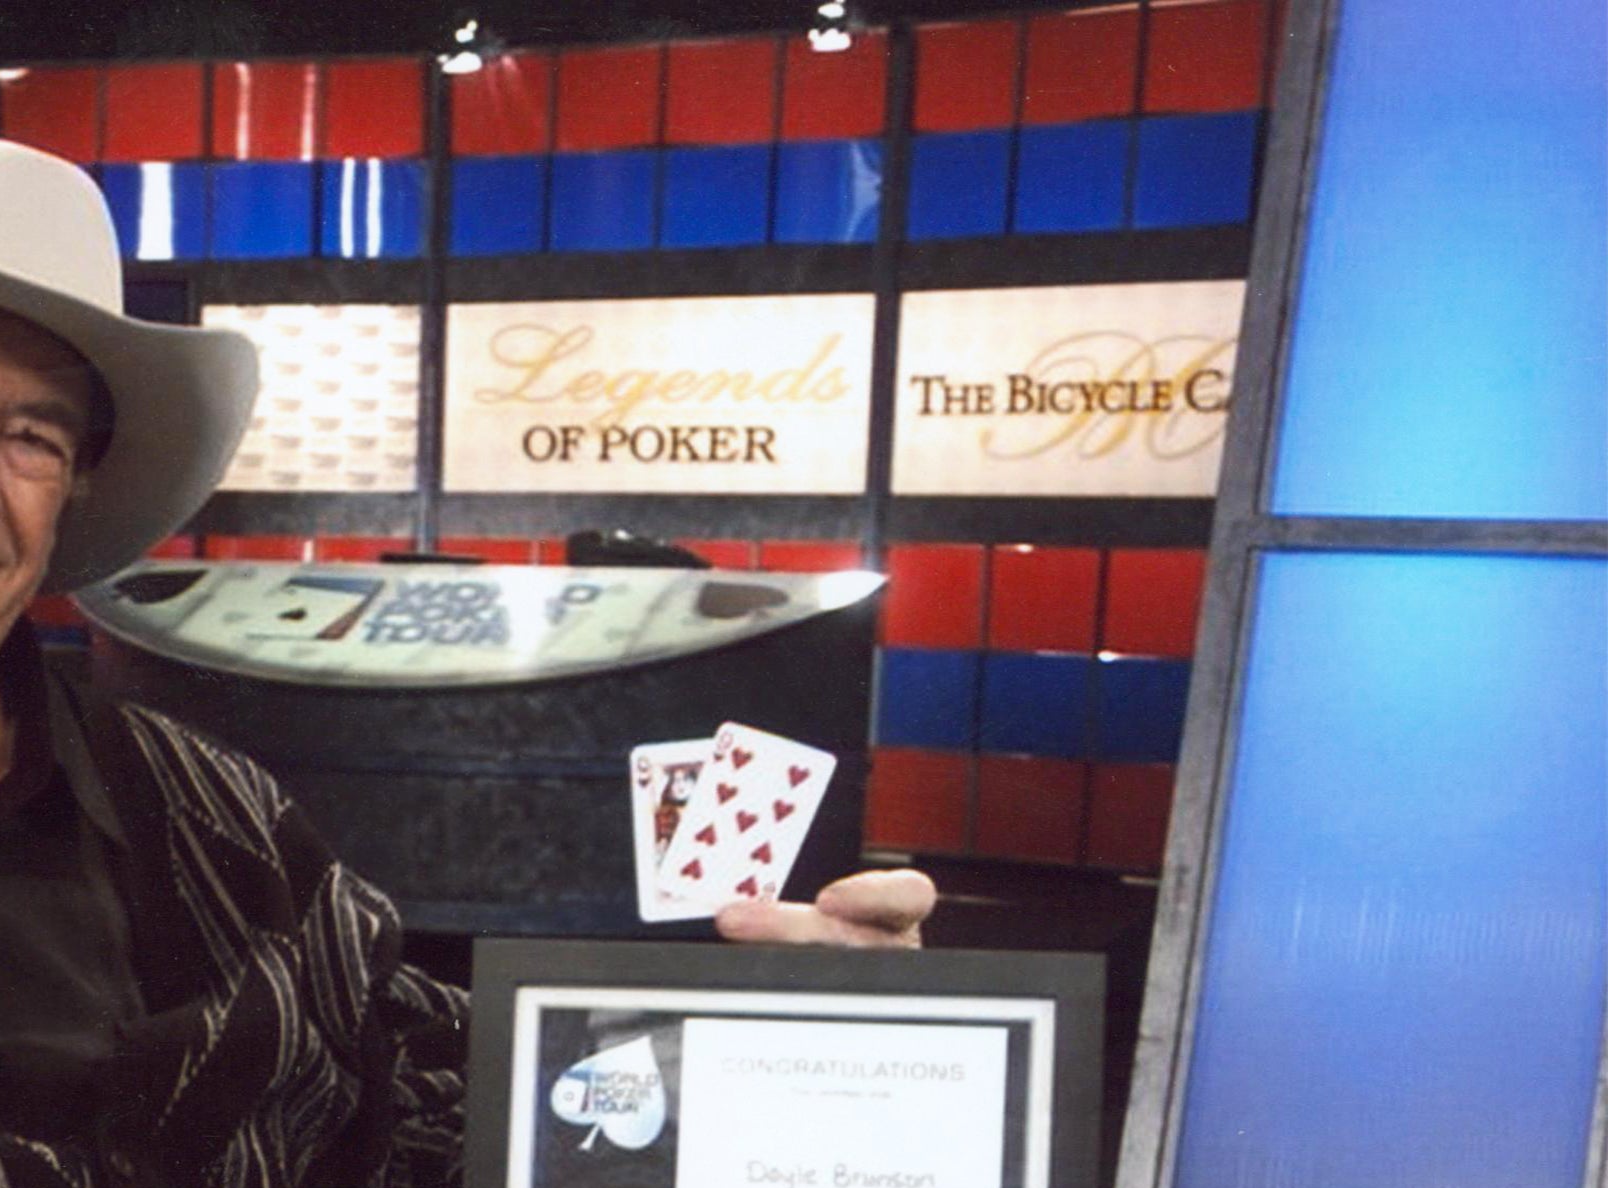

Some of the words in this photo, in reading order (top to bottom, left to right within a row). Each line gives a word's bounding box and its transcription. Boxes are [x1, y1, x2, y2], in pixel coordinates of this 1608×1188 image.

[474, 323, 852, 430] Legends
[910, 375, 996, 417] THE
[1004, 373, 1175, 414] BICYCLE
[521, 424, 586, 464] OF
[597, 424, 779, 464] POKER
[833, 1163, 937, 1188] Brunson
